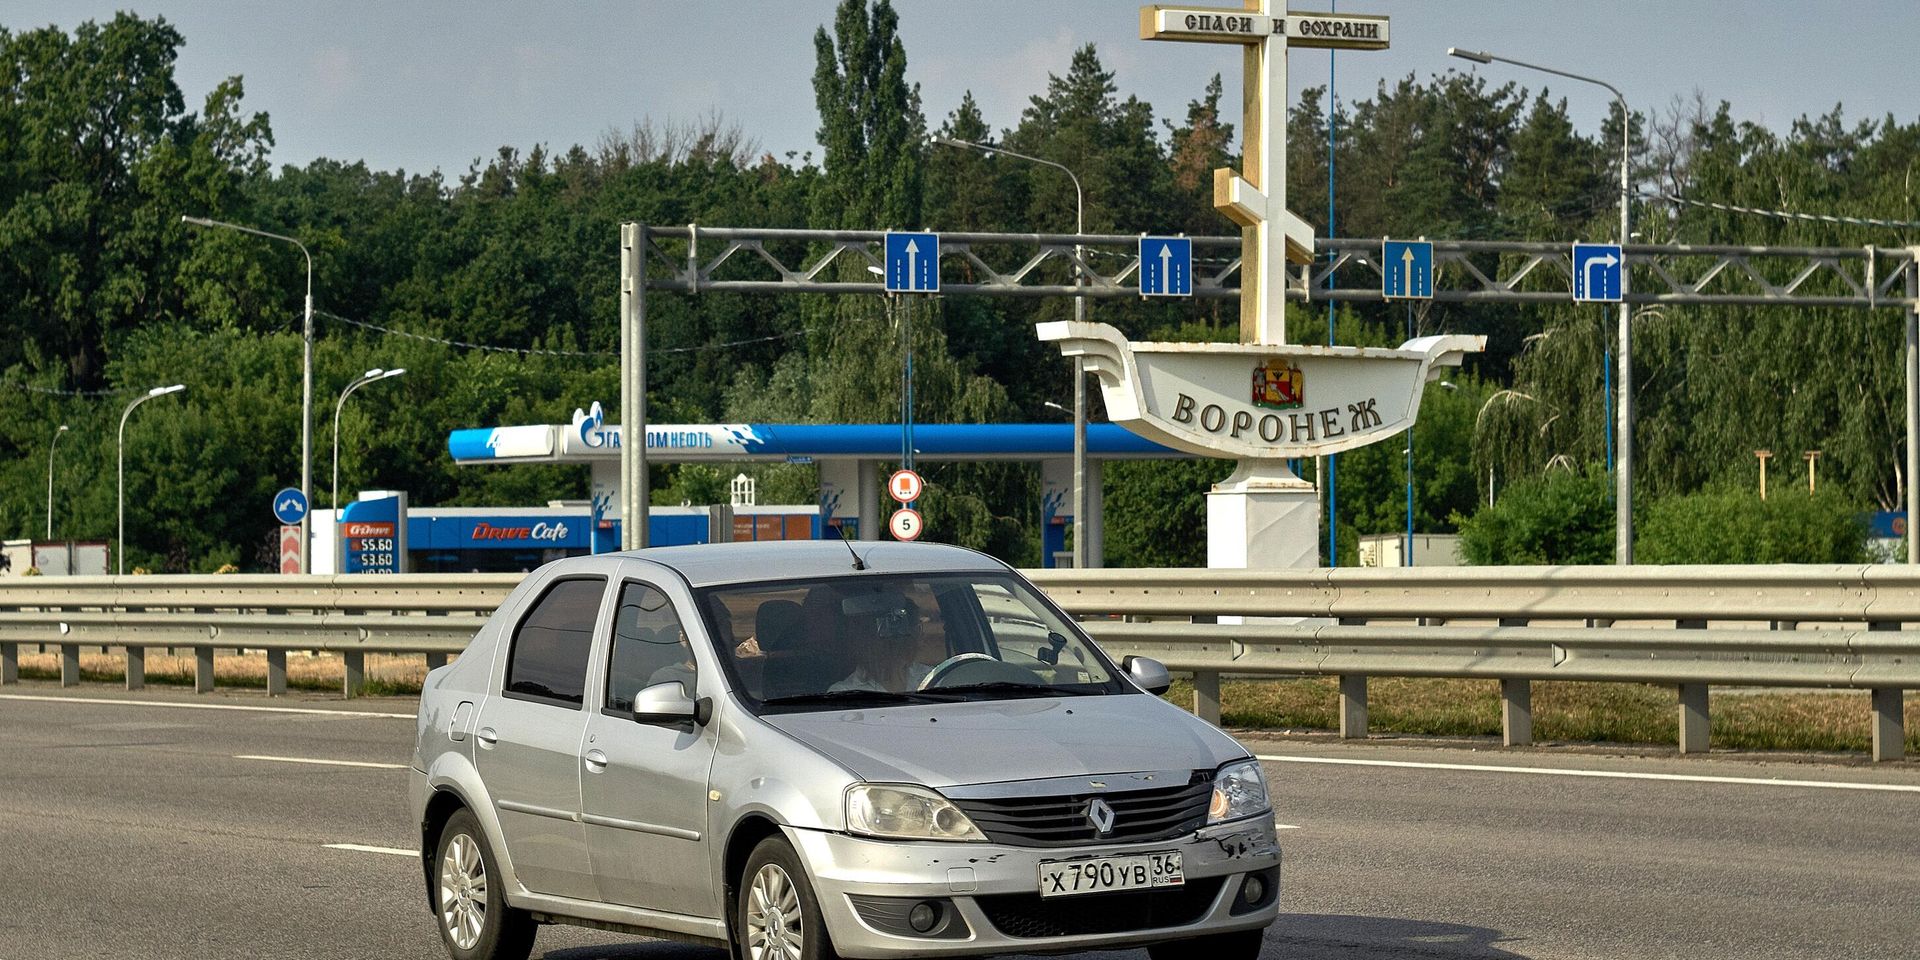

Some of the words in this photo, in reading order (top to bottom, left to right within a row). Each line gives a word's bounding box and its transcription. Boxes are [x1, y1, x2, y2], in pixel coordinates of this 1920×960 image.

[1185, 14, 1252, 33] СПАСИ
[1272, 18, 1286, 34] И
[1299, 19, 1378, 39] СОХРАНИ
[1172, 392, 1383, 443] ВОРОНЕЖ
[472, 522, 531, 541] DRIVE
[902, 518, 911, 531] 5
[361, 538, 393, 551] 55.60
[361, 553, 393, 566] 53.60
[1152, 854, 1175, 876] 36
[1153, 875, 1169, 884] RUS
